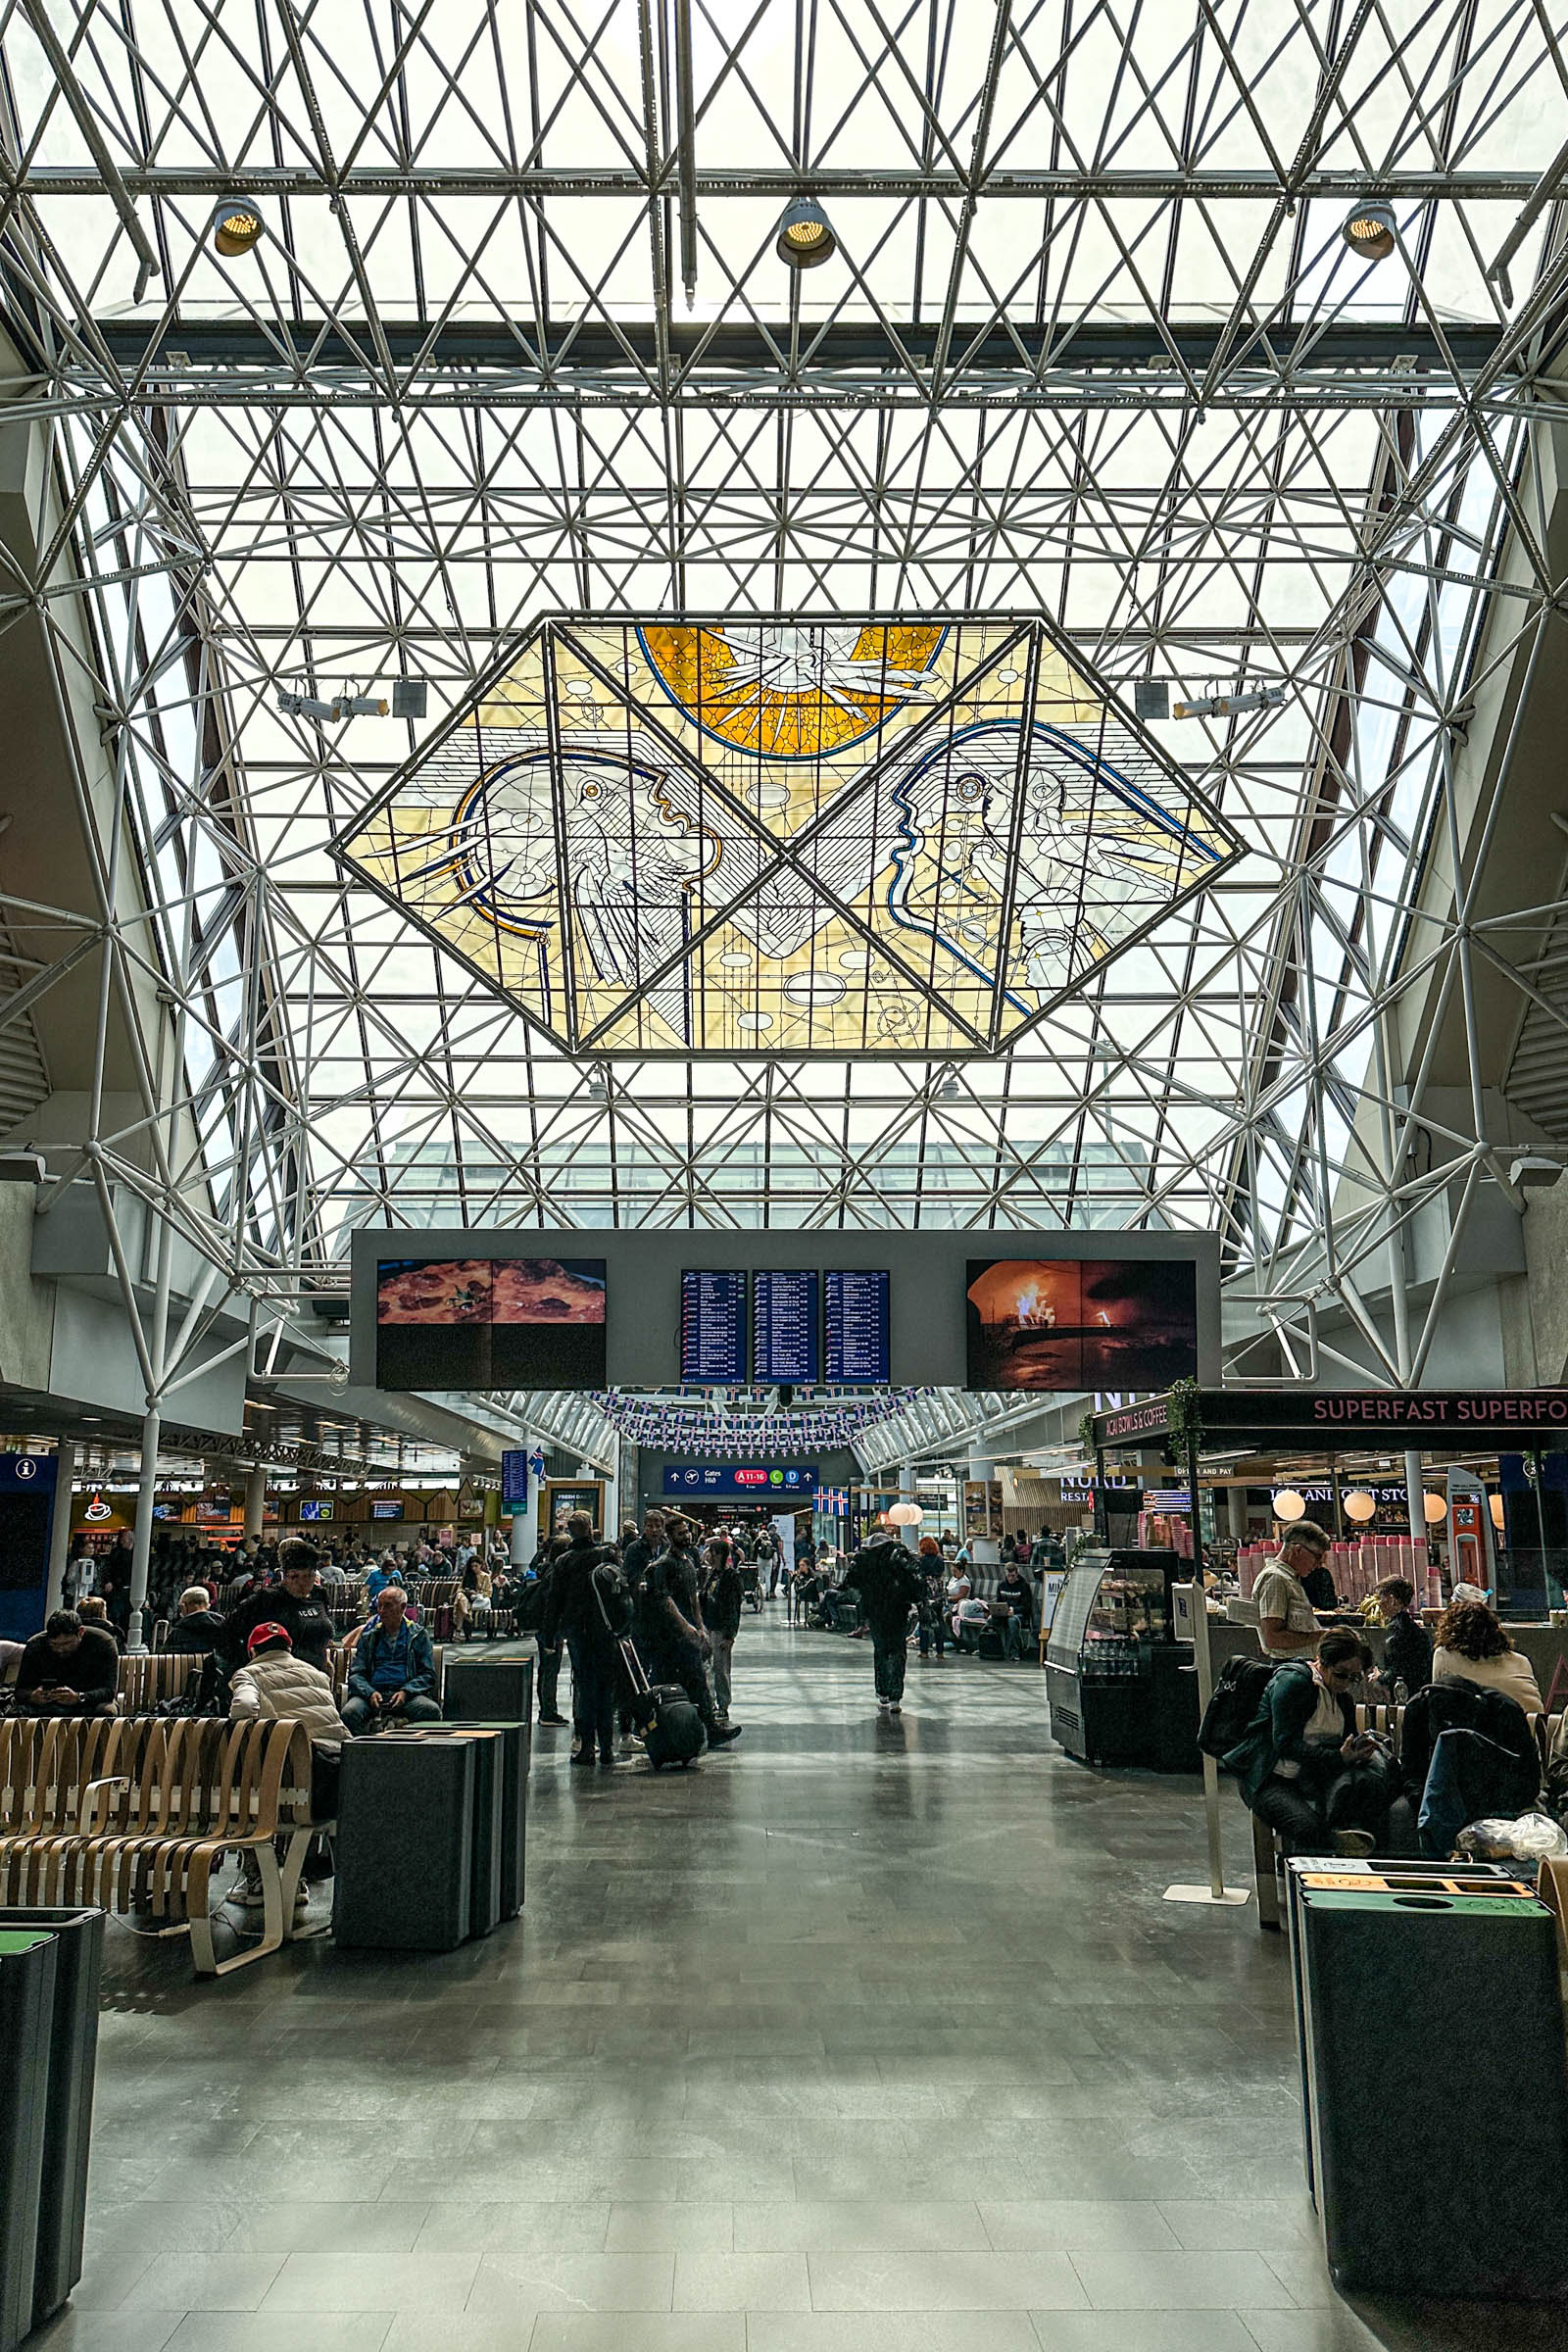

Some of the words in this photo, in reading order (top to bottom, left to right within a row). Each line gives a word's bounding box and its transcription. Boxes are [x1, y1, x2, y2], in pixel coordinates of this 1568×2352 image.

[1314, 1399, 1448, 1420] SUPERFAST
[1457, 1399, 1568, 1420] SUPERFO
[1118, 1412, 1139, 1434] BOWLS
[1143, 1404, 1168, 1428] COFFEE
[738, 1472, 746, 1481] A
[789, 1472, 797, 1481] D
